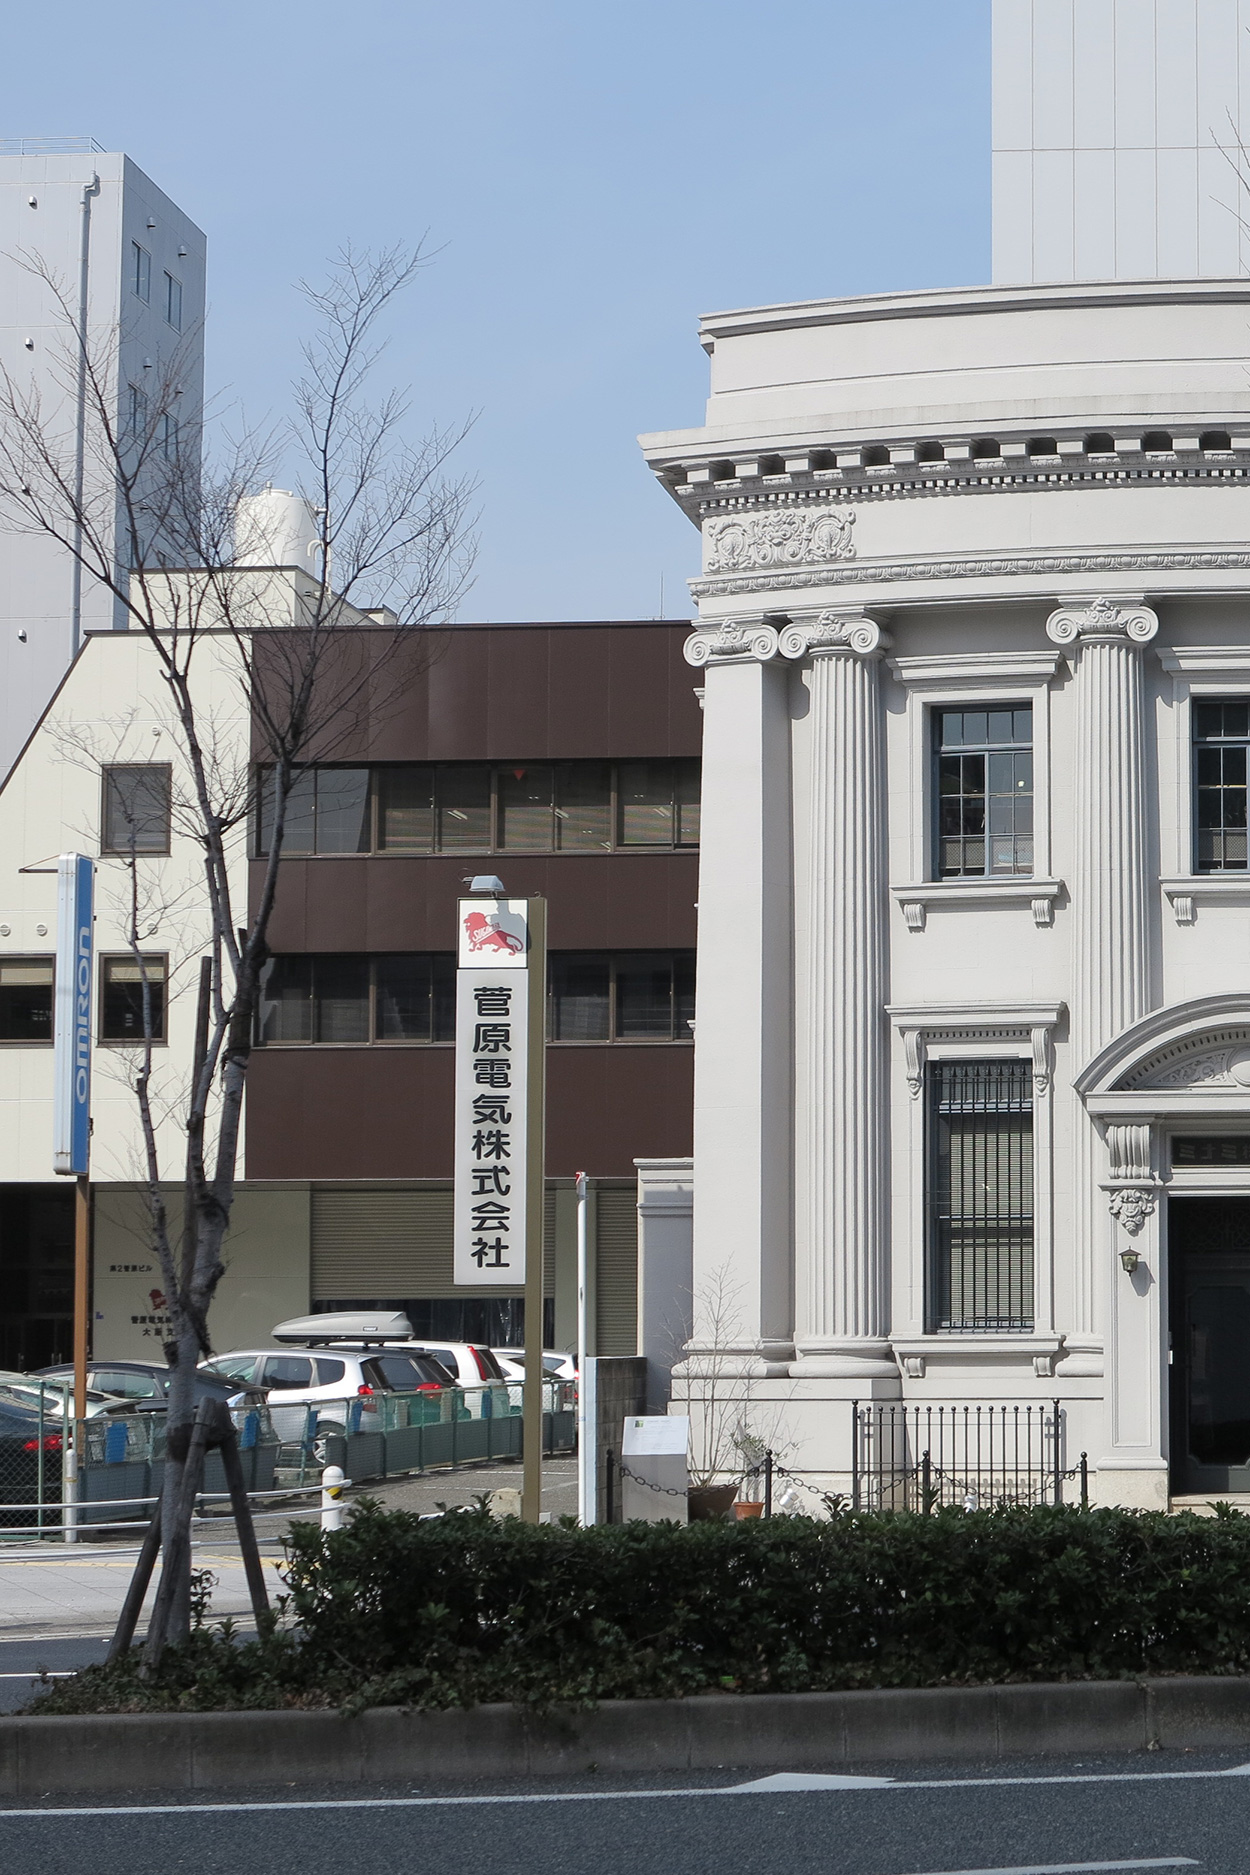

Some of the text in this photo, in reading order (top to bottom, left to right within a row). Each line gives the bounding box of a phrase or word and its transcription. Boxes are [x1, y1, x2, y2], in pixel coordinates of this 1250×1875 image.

[470, 986, 512, 1269] 菅原電気株式会社
